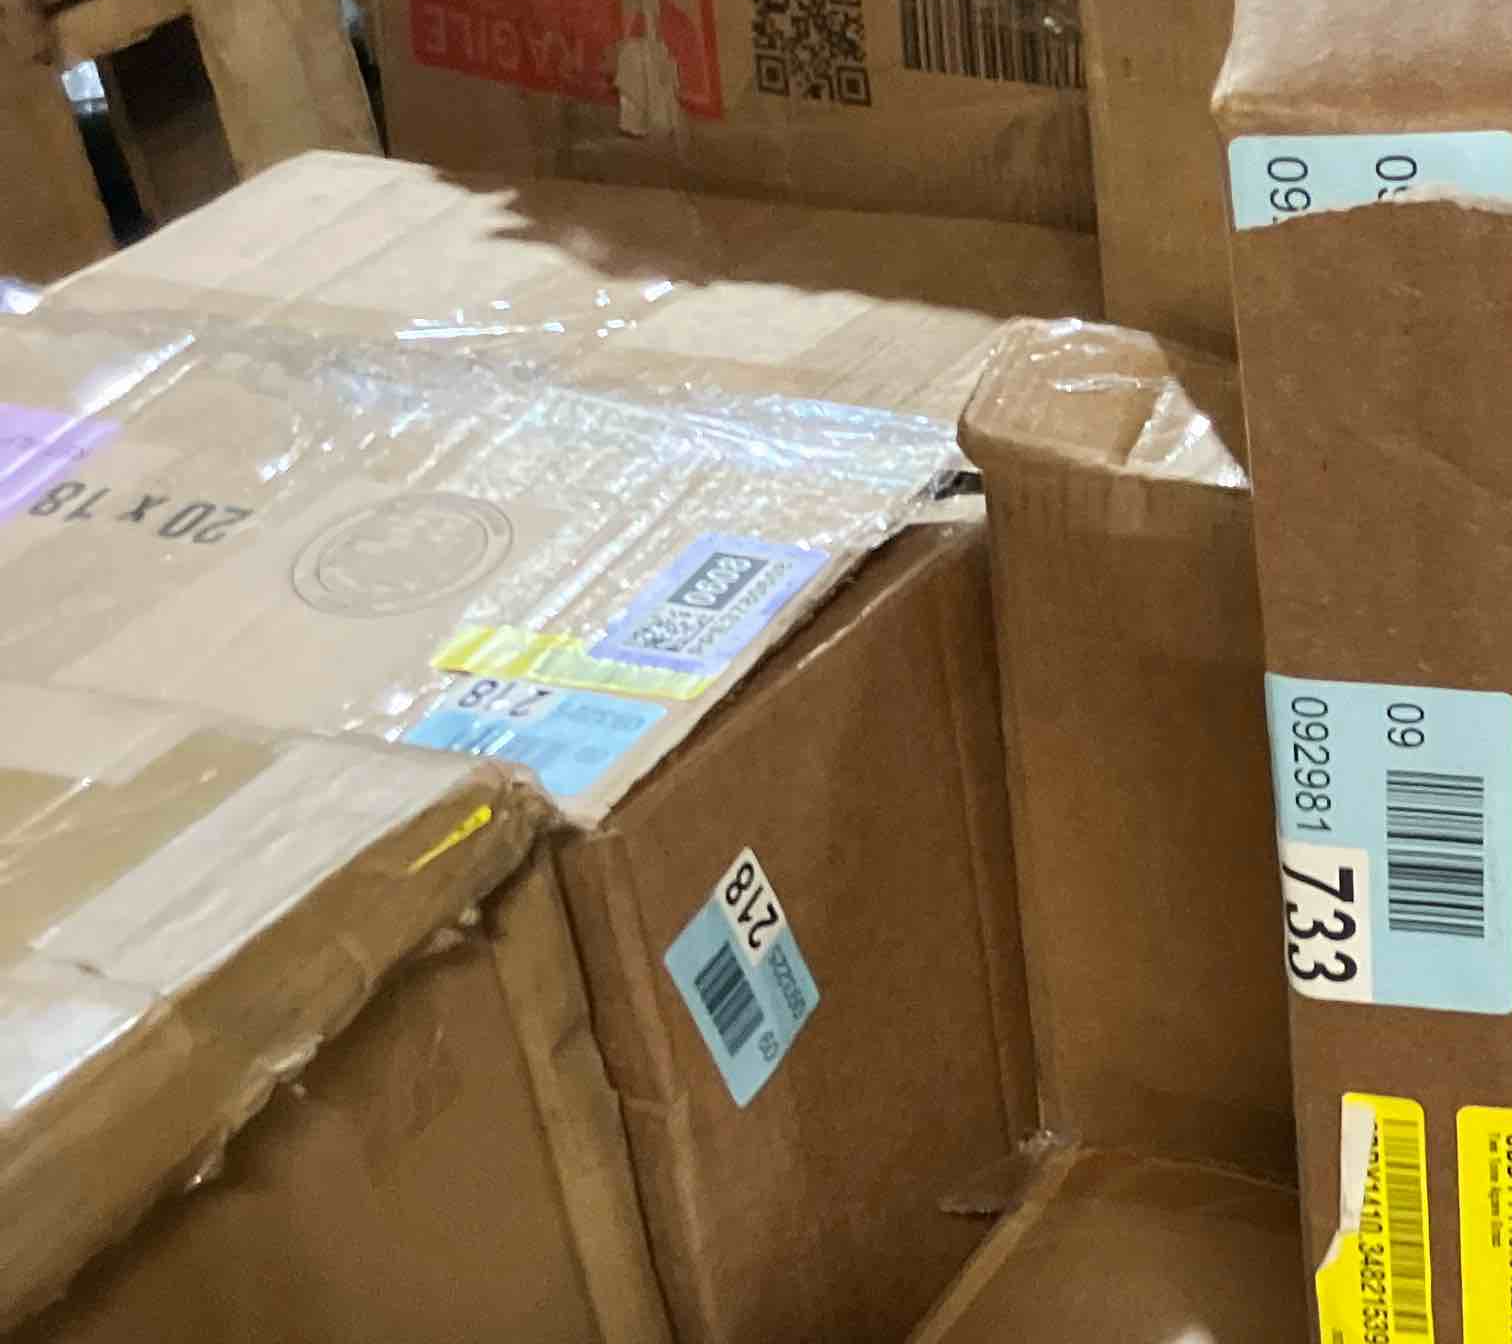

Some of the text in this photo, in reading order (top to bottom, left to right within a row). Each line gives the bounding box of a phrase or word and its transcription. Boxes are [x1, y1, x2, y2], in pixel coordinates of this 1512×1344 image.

[1267, 157, 1311, 224] 09
[28, 481, 111, 522] 18
[158, 503, 254, 544] 20
[1385, 703, 1426, 750] 09
[1291, 696, 1332, 832] 092981
[725, 862, 779, 949] 218
[1282, 863, 1358, 982] 733
